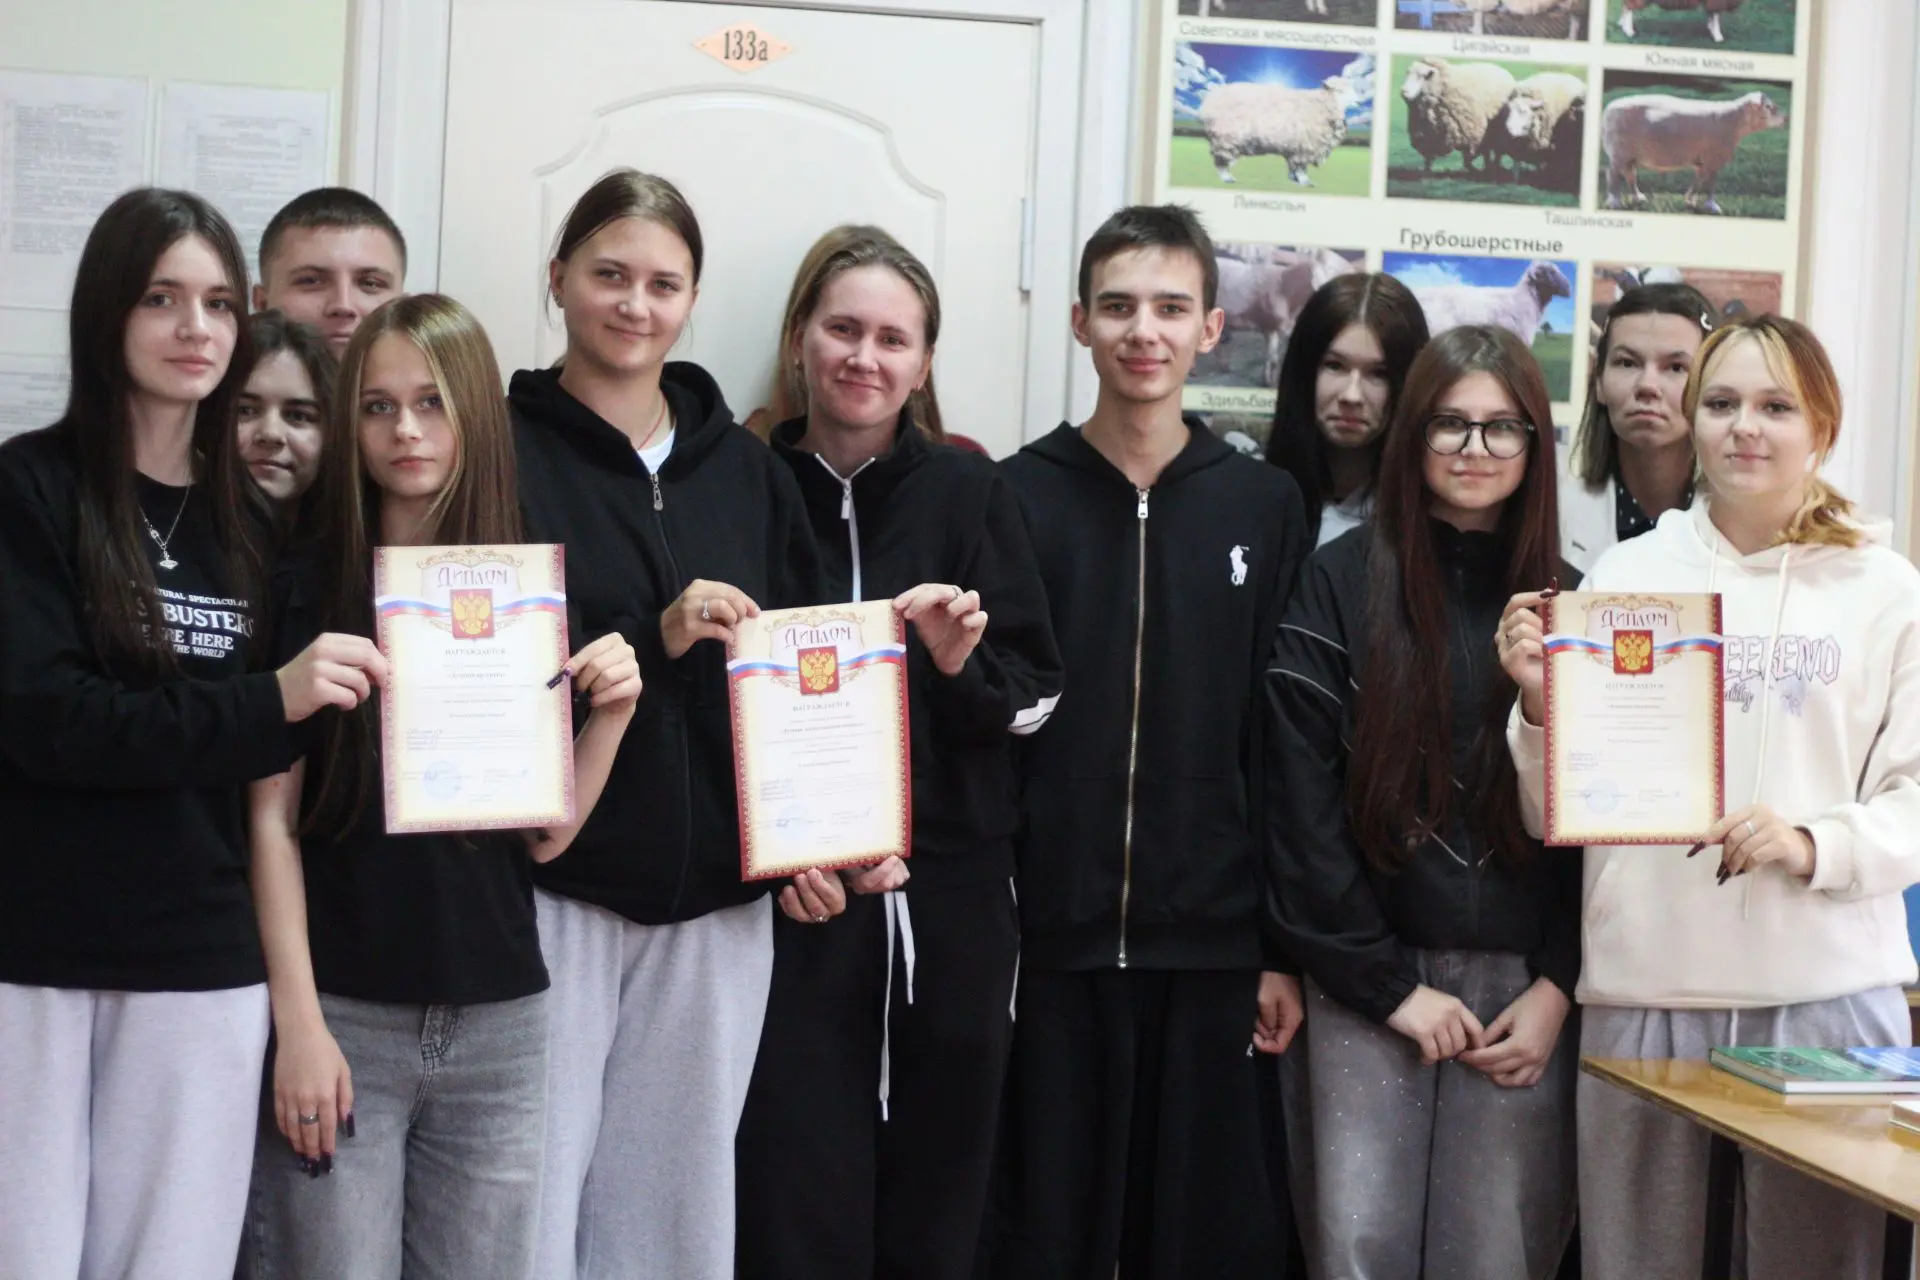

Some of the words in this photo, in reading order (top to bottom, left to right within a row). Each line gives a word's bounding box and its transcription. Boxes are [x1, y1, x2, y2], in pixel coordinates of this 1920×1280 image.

[1179, 20, 1259, 39] Советская
[723, 29, 768, 61] 133а
[1644, 51, 1698, 68] Южная
[1399, 227, 1564, 254] Грубошерстные
[1201, 391, 1274, 410] Эдильбае
[191, 631, 235, 651] HERE
[193, 646, 226, 659] WORLD
